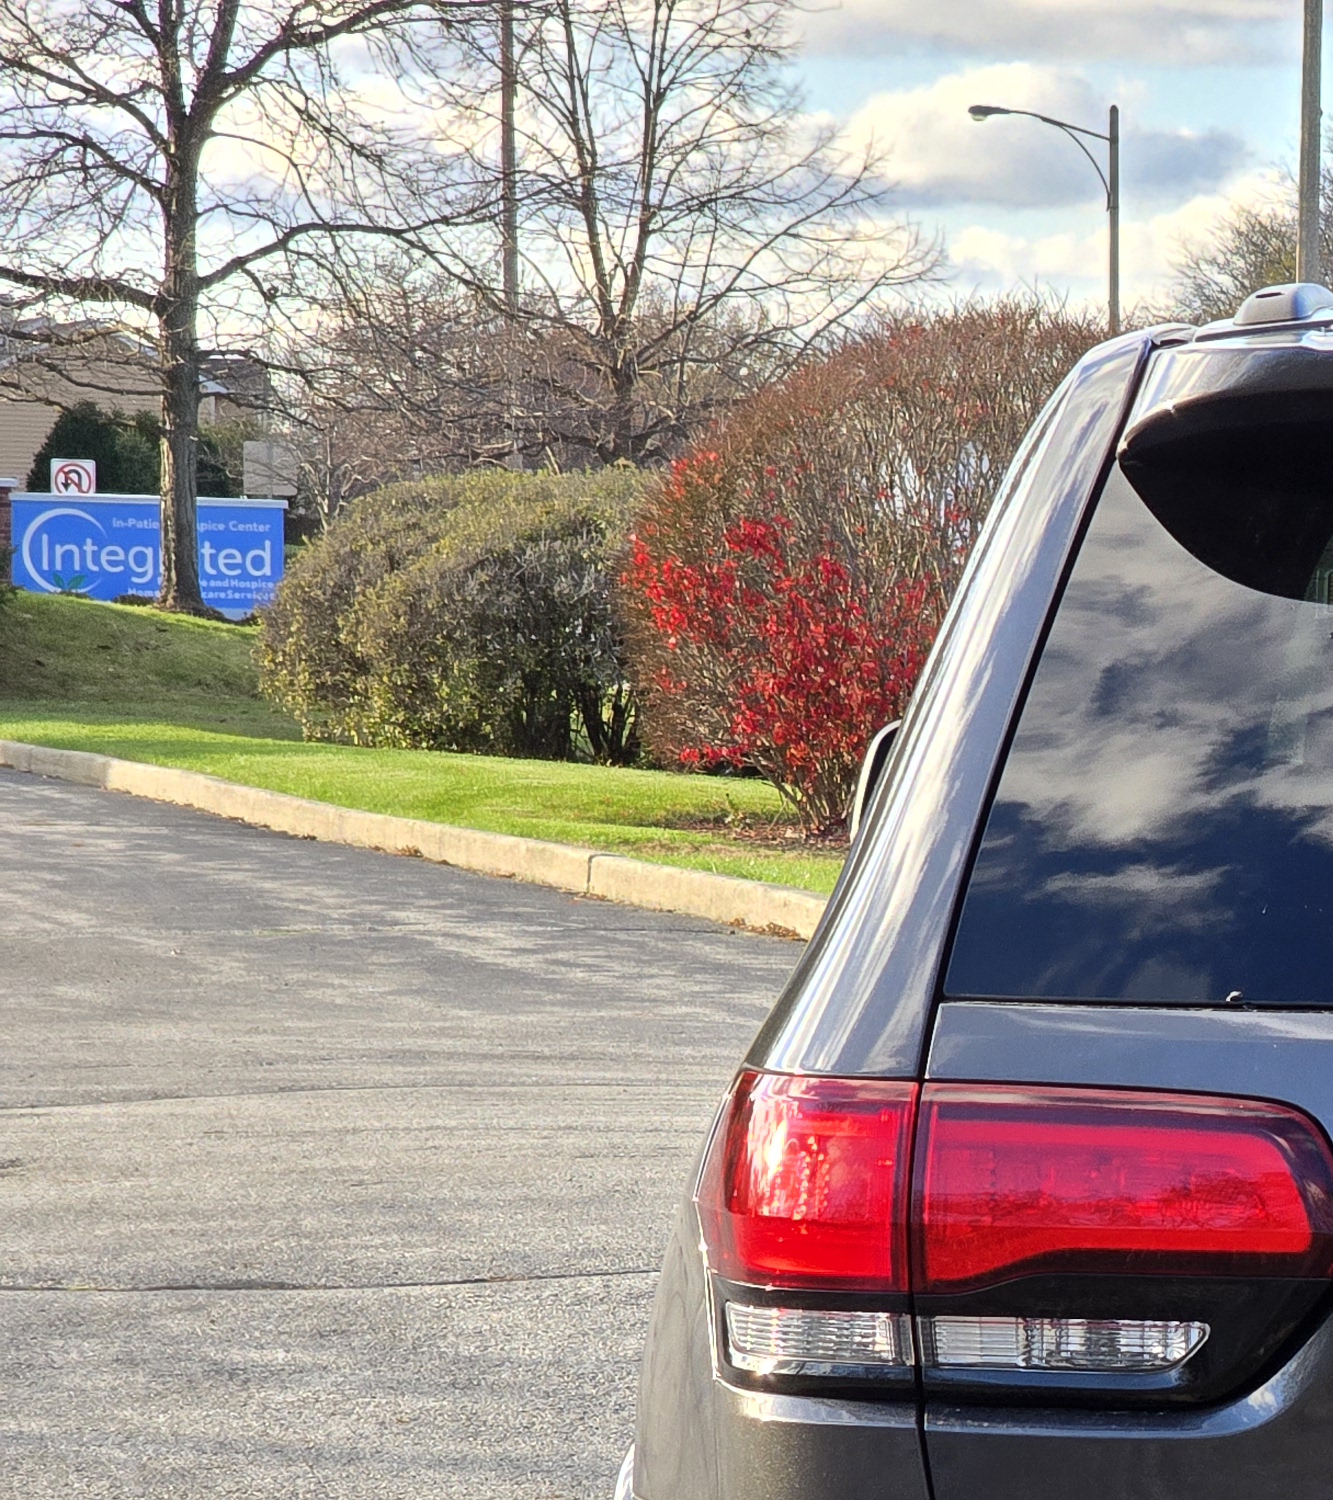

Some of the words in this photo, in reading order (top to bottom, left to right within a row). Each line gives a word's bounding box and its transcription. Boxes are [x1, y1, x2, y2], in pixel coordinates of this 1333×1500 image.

[112, 517, 160, 530] In-Patie
[229, 520, 271, 532] Center
[41, 533, 271, 583] Integted
[230, 578, 275, 589] Hospice
